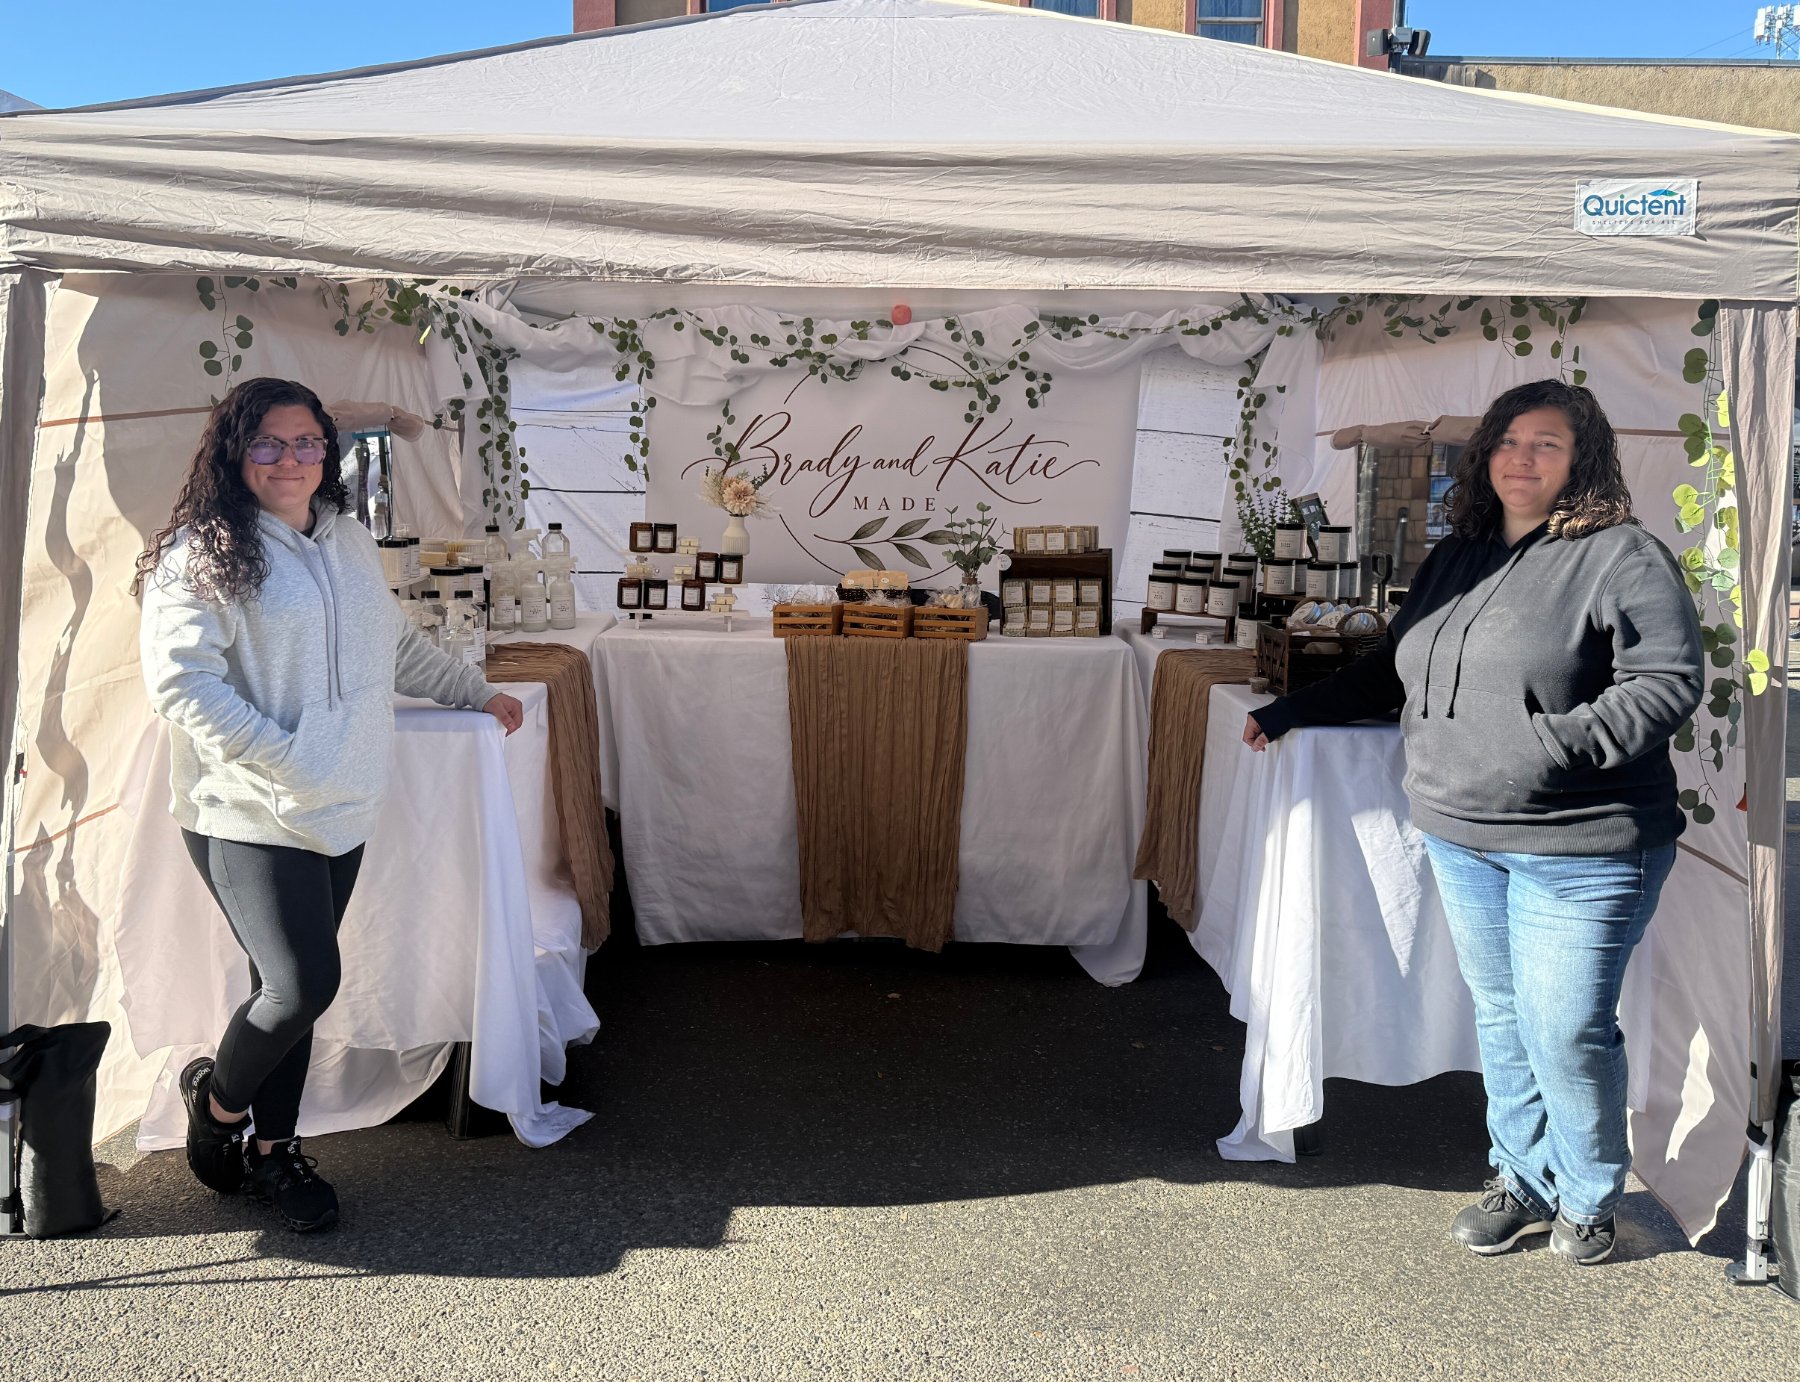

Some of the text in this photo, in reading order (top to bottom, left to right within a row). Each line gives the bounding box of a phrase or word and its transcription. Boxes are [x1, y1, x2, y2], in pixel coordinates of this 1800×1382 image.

[1583, 193, 1687, 217] Quictent
[681, 411, 1101, 518] Brady and Katie
[852, 496, 937, 512] MADE
